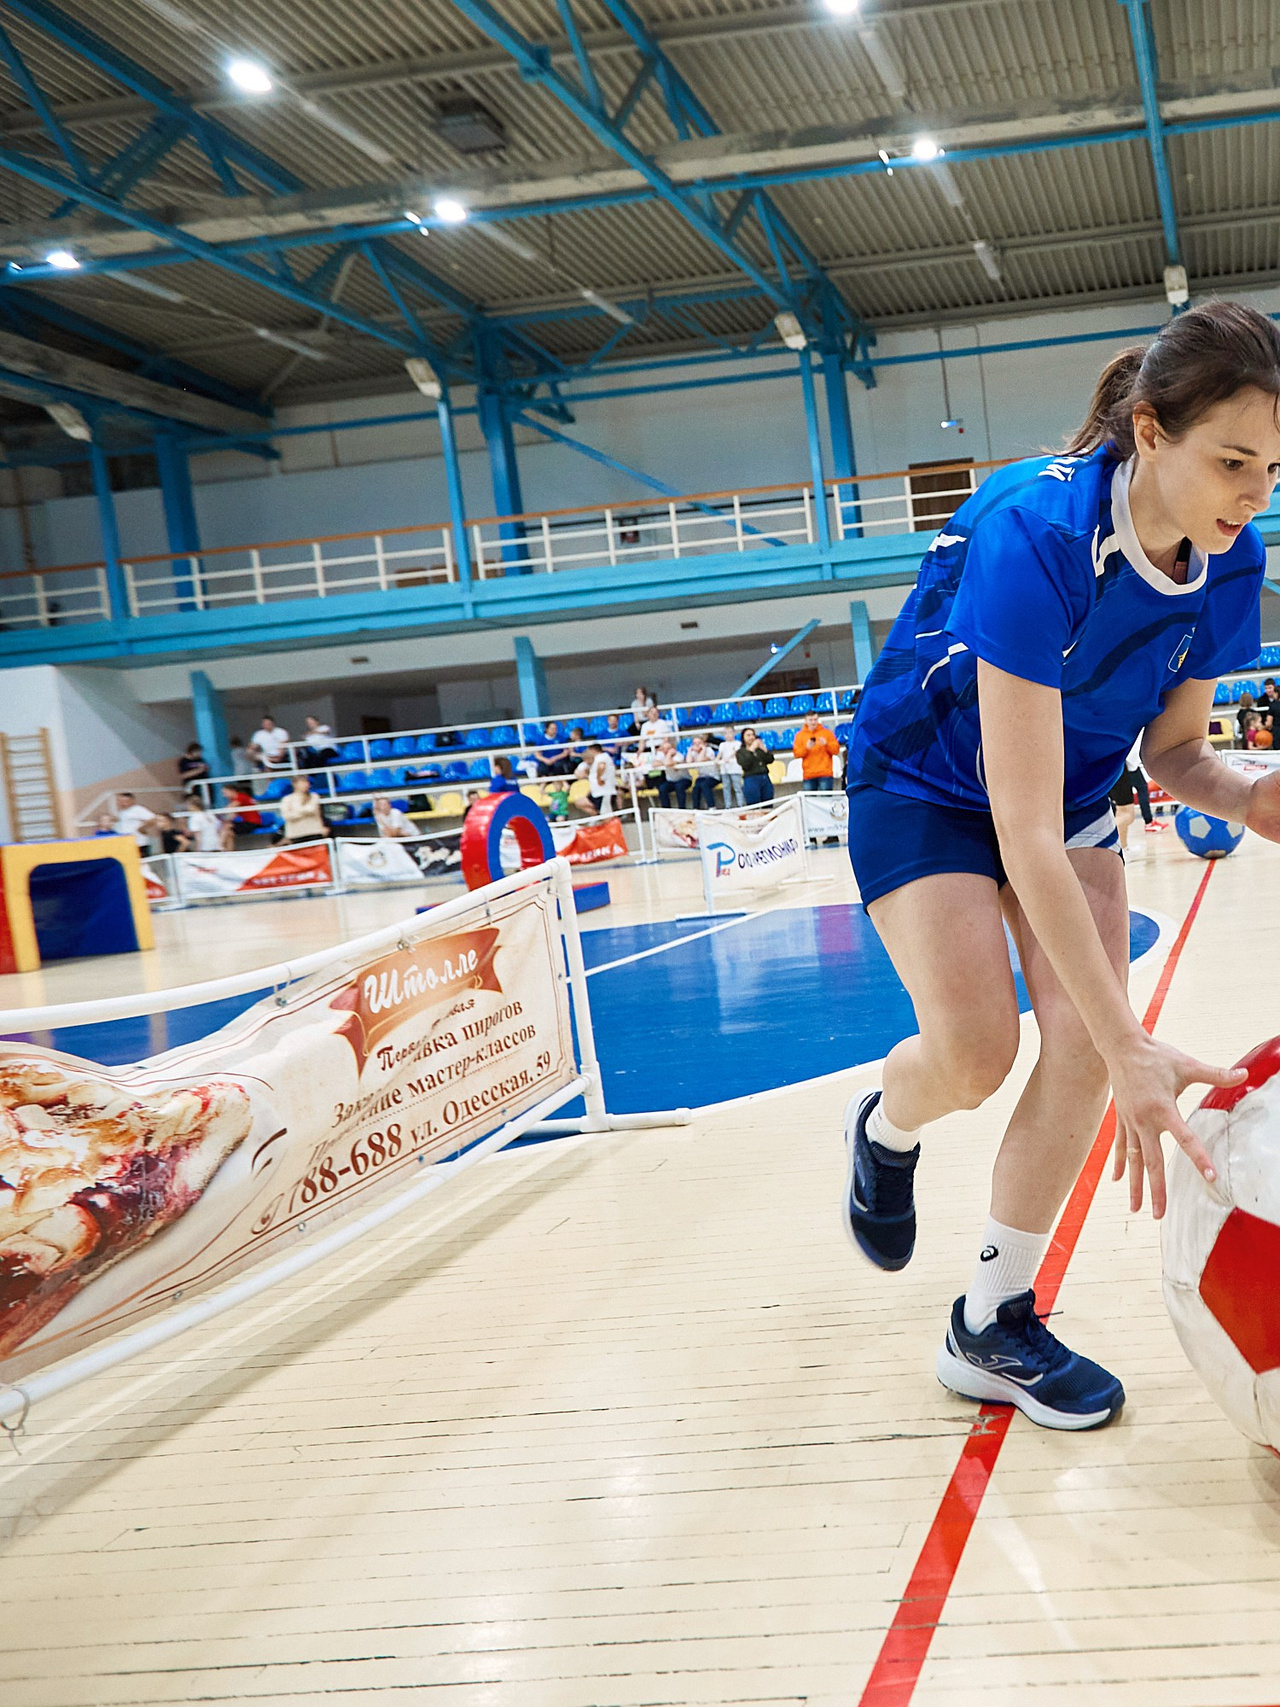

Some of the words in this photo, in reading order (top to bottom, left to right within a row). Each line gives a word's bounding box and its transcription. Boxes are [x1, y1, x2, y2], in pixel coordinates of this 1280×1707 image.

[364, 948, 479, 1015] Штолле
[461, 1000, 524, 1043] пирогов
[407, 1024, 537, 1099] мастер-классов
[410, 1120, 439, 1152] ул.
[535, 1050, 551, 1079] 59
